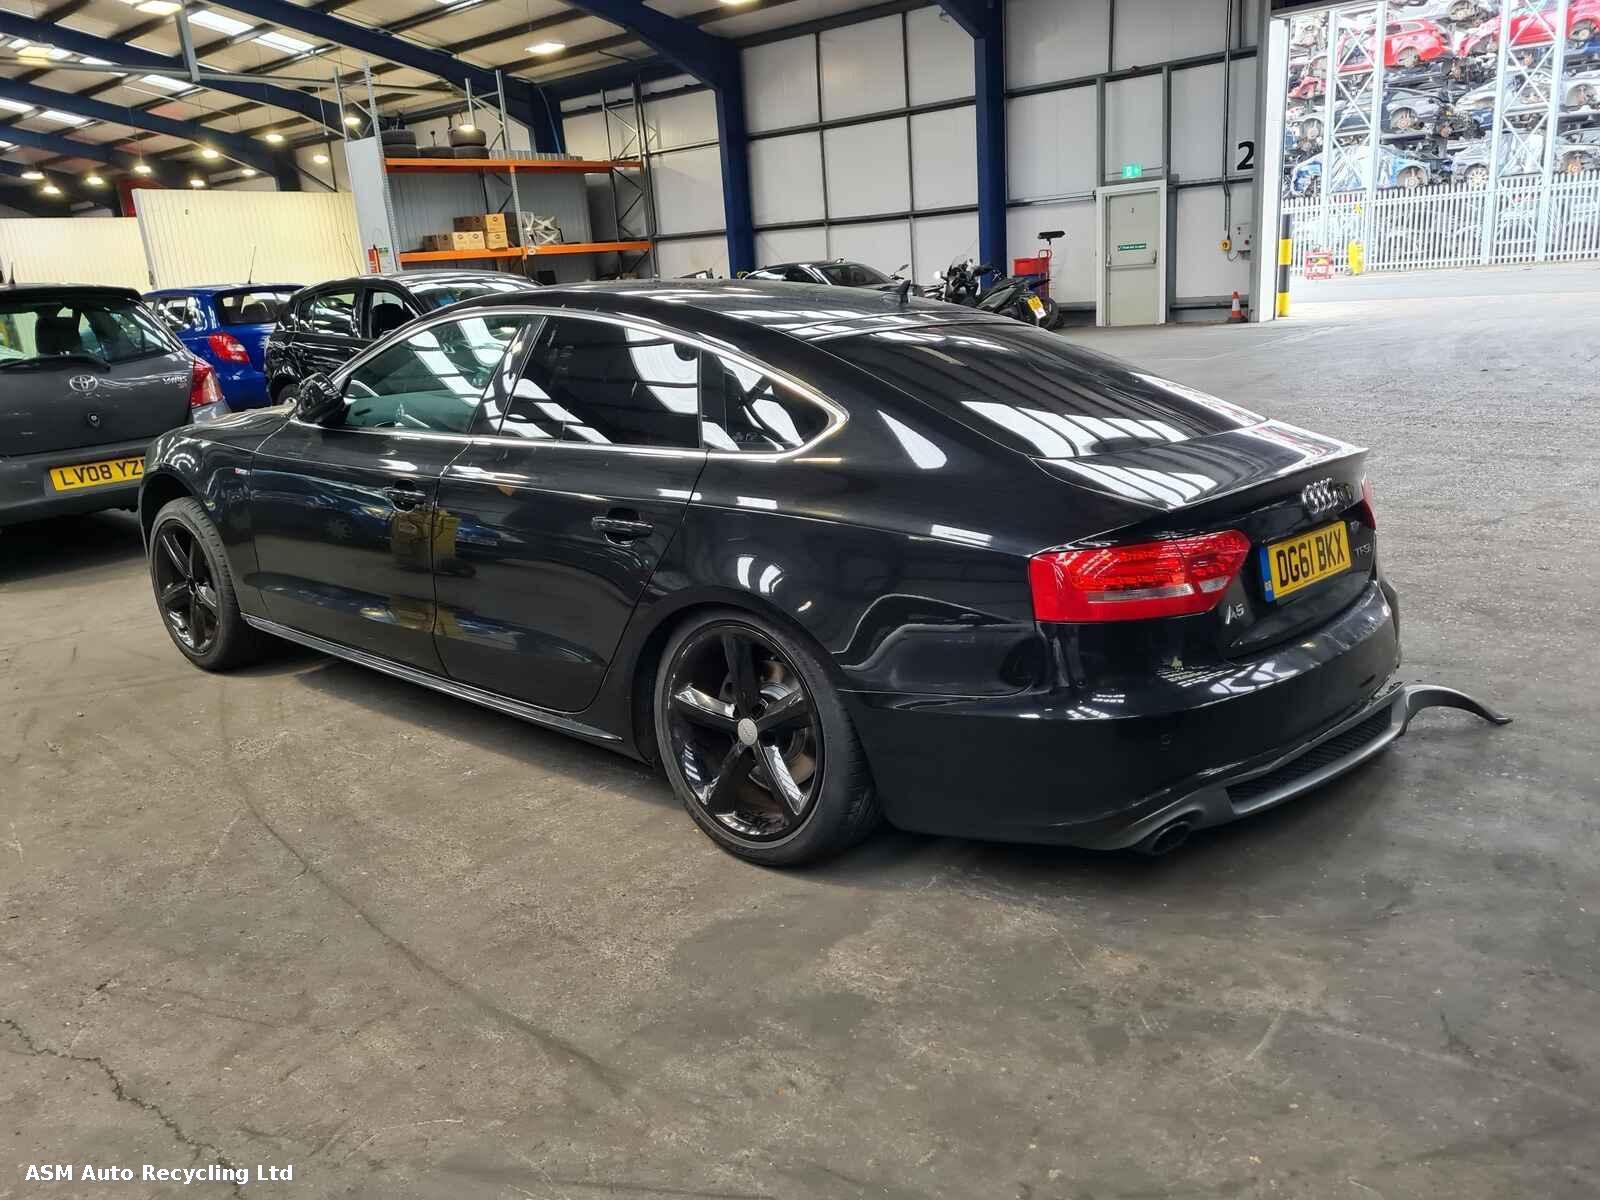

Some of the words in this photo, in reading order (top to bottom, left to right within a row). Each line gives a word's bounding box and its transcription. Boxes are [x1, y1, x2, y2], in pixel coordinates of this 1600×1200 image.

[1236, 141, 1254, 170] 2
[60, 464, 112, 485] LV08
[1276, 539, 1315, 588] DG61
[1315, 527, 1346, 571] BKX
